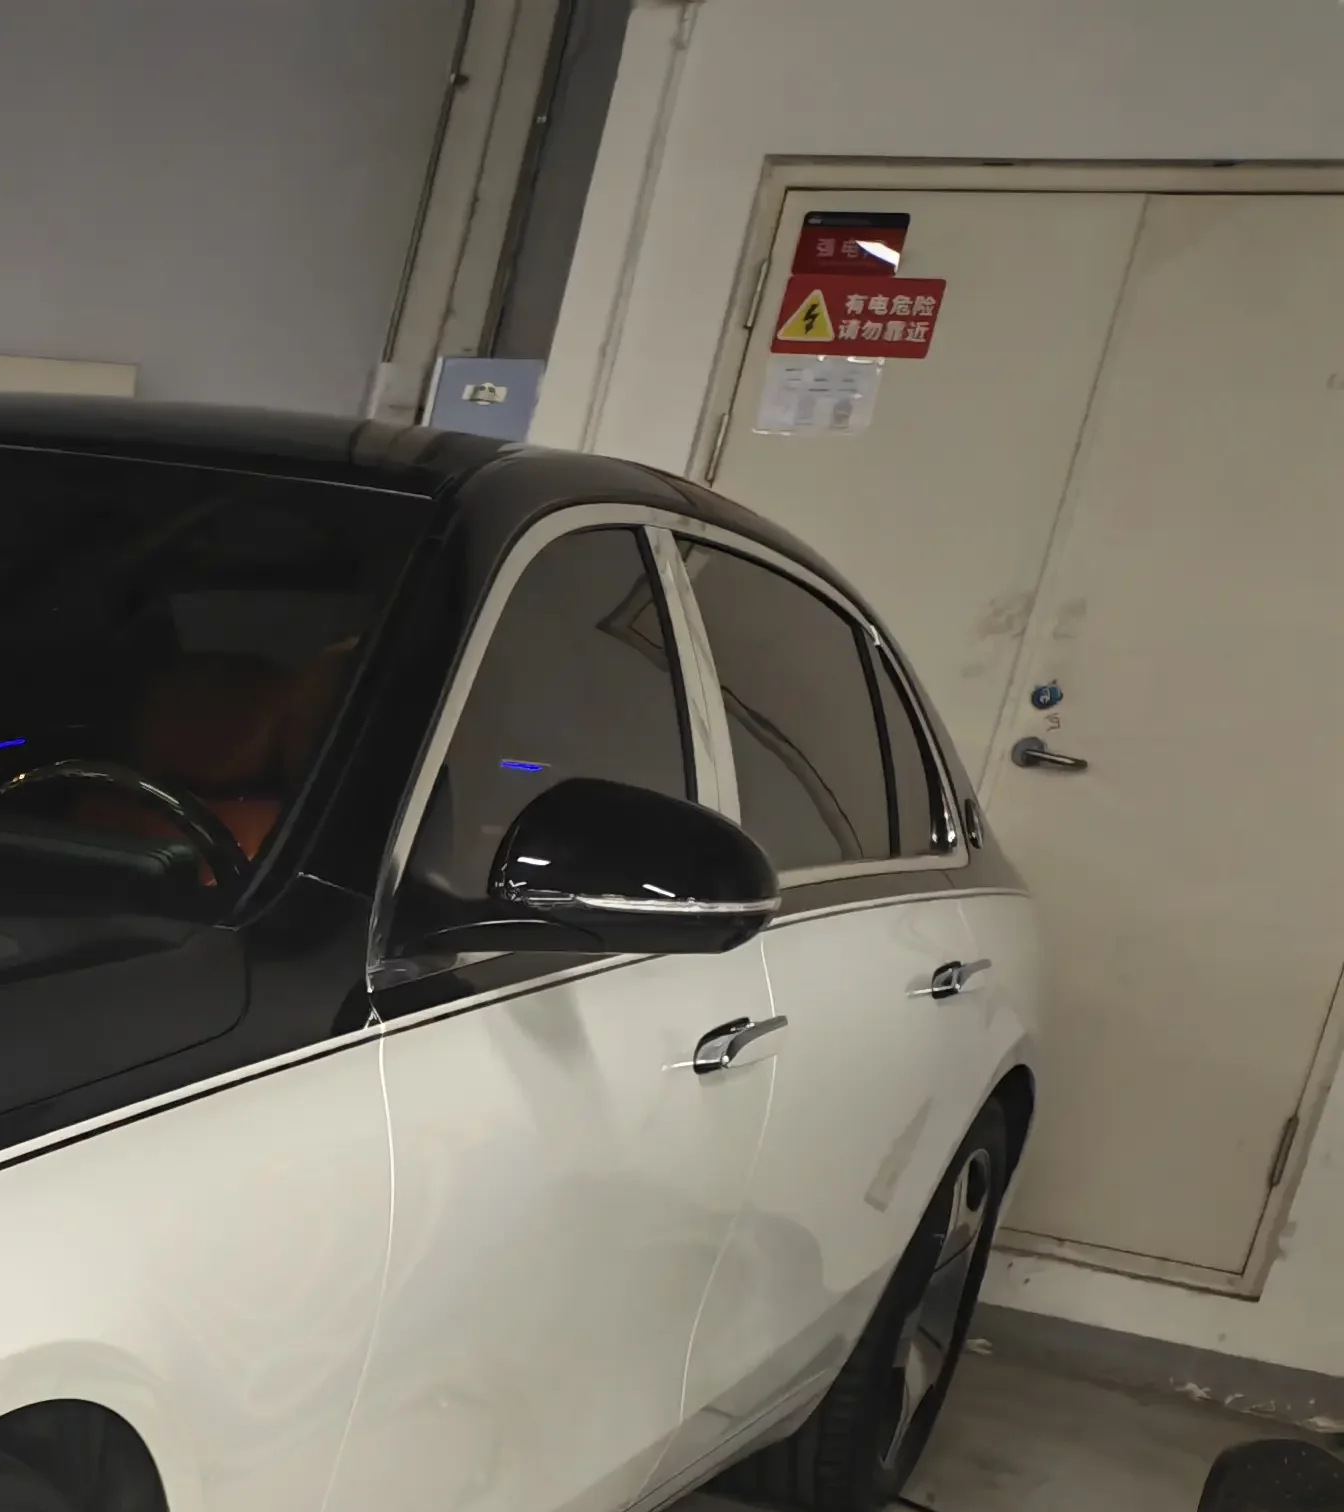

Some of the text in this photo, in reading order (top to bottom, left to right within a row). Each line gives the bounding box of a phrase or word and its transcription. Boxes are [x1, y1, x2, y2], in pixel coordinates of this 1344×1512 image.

[844, 293, 937, 318] 有电危险
[837, 319, 931, 344] 请勿靠近
